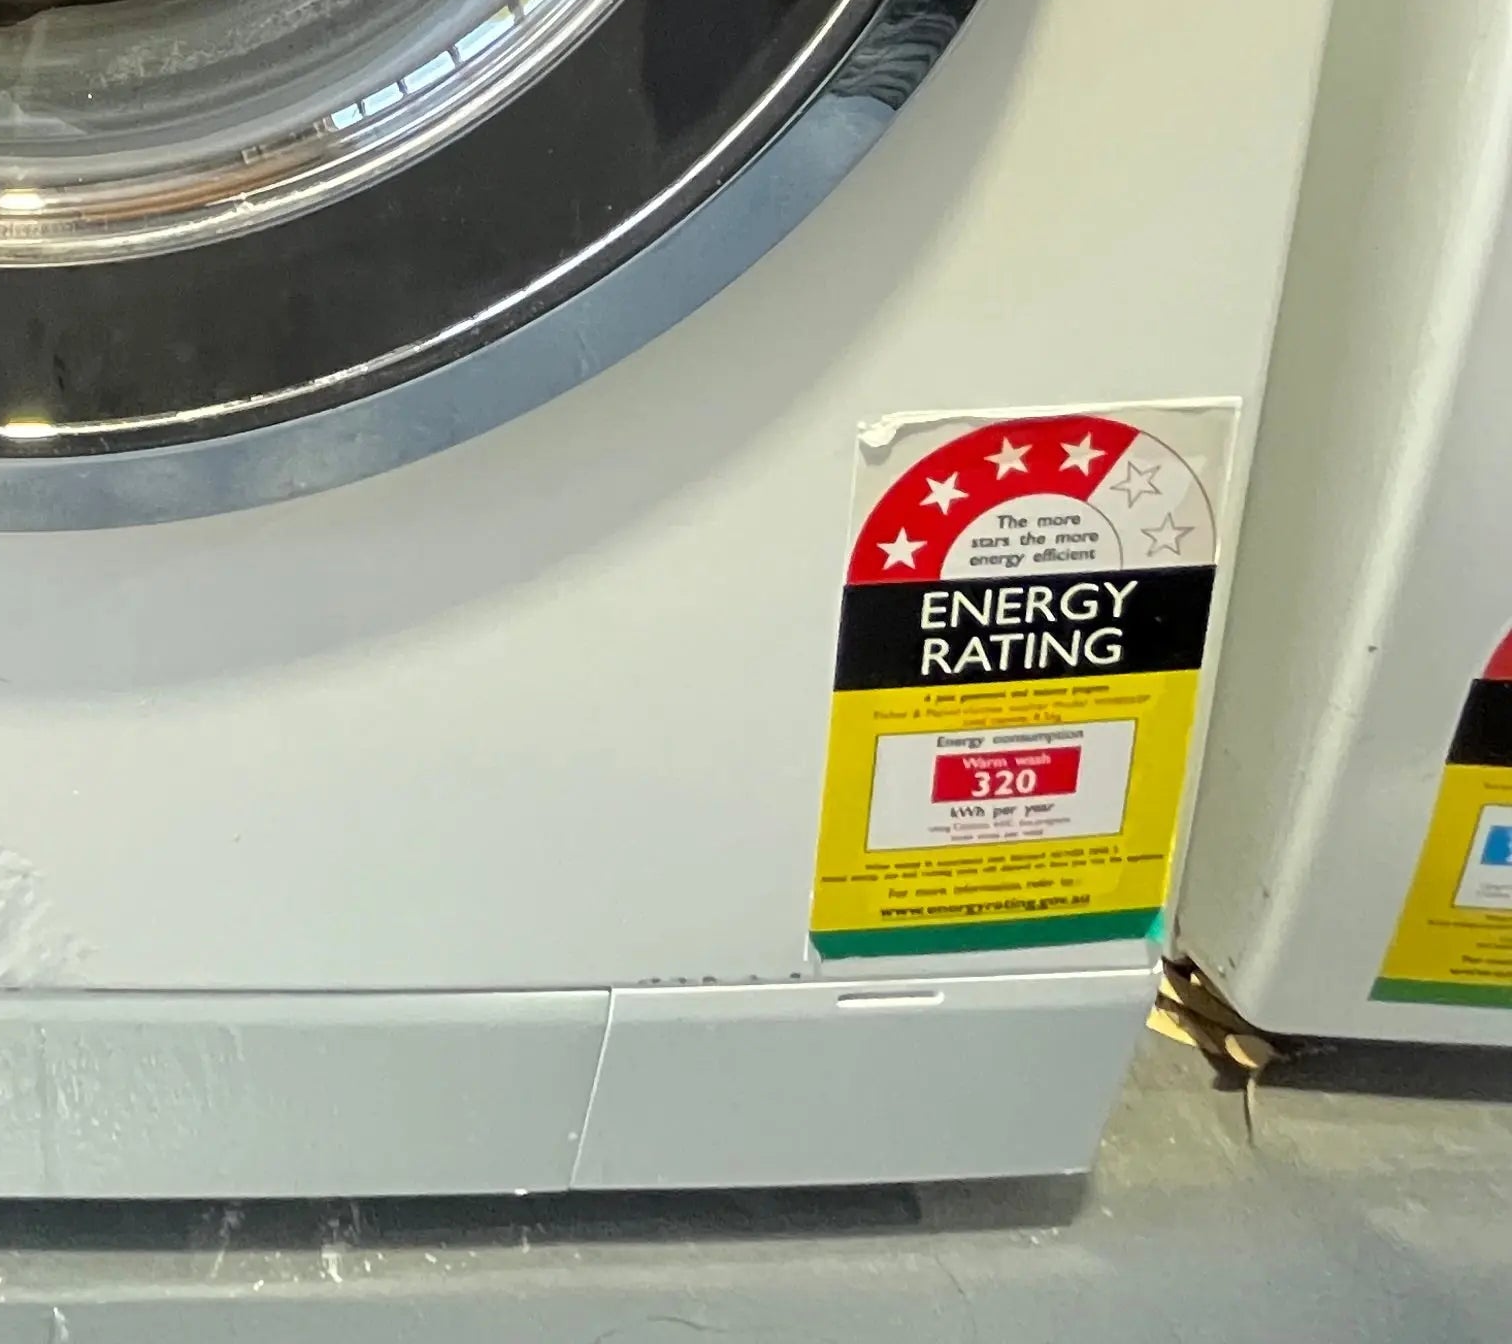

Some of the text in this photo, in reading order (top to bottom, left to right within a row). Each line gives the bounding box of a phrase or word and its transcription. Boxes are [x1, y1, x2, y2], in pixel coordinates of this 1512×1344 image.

[997, 513, 1082, 530] The more
[971, 531, 1100, 549] stars the more
[969, 547, 1097, 569] energy efficient
[920, 580, 1138, 630] ENERGY
[920, 627, 1124, 677] RATING
[936, 727, 1086, 750] Energy consumption
[962, 752, 1053, 770] Warm wash
[970, 767, 1038, 799] 320
[992, 805, 1018, 818] per
[1024, 801, 1056, 817] year
